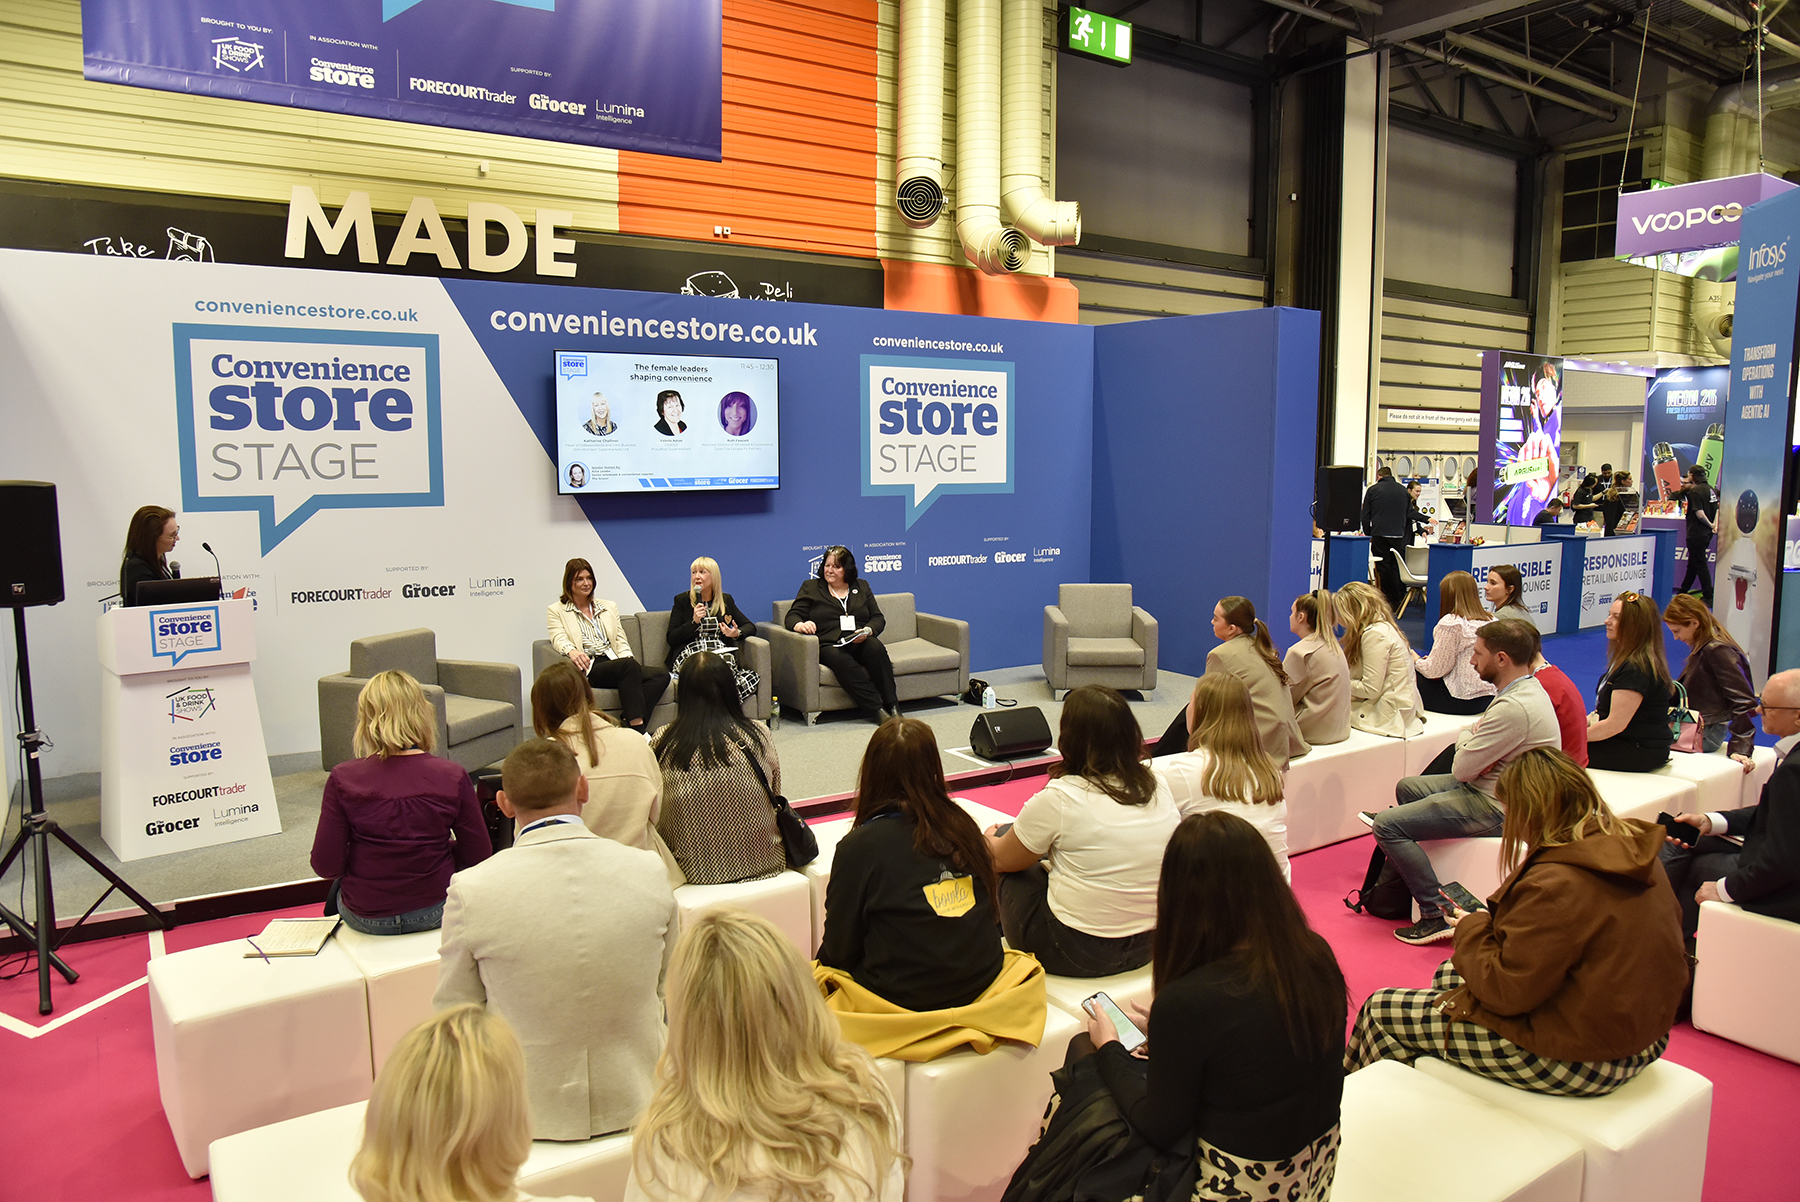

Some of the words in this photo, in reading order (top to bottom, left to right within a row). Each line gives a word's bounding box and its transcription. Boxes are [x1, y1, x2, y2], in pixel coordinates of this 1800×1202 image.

[201, 17, 234, 27] BROUGHT
[233, 45, 254, 54] FOOD
[318, 37, 360, 48] ASSOCIATION
[222, 54, 249, 64] SHOWS
[228, 50, 251, 58] DRINK
[311, 58, 374, 74] Convenience
[510, 67, 543, 77] SUPPORTED
[310, 67, 375, 89] store
[410, 78, 516, 104] FORECOURTtrader
[529, 93, 586, 116] Grocer
[596, 99, 644, 118] Lumina
[596, 114, 632, 124] Intelligence
[284, 185, 578, 277] MADE
[84, 237, 155, 259] Take
[1749, 242, 1786, 270] Infosys
[760, 282, 793, 298] Deli
[195, 300, 418, 322] conveniencestore.co.uk
[490, 310, 818, 346] conveniencestore.co.uk
[873, 336, 1003, 353] conveniencestore.co.uk
[1744, 343, 1776, 361] TRANSFORM
[211, 354, 410, 382] Convenience
[1742, 363, 1774, 381] OPERATIONS
[630, 374, 662, 382] shaping
[882, 377, 997, 398] Convenience
[1750, 385, 1764, 399] WITH
[1666, 390, 1699, 406] NEON
[1700, 389, 1717, 406] 2K
[208, 381, 413, 432] store
[1741, 404, 1763, 419] AGENTIC
[1763, 404, 1770, 418] AI
[879, 398, 998, 436] store
[212, 443, 379, 481] STAGE
[879, 444, 976, 472] STAGE
[995, 552, 1026, 563] Grocer
[1034, 547, 1060, 556] Lumina
[864, 559, 902, 573] store
[929, 554, 988, 566] FORECOURTtrader
[1584, 551, 1647, 571] RESPONSIBLE
[469, 576, 515, 589] Lumina
[1583, 572, 1618, 585] RETAILING
[1620, 569, 1646, 581] LOUNGE
[402, 584, 456, 599] Grocer
[1522, 580, 1550, 593] OUNGE
[291, 588, 392, 604] FORECOURTtrader
[1599, 596, 1612, 604] store
[159, 613, 211, 623] Convenience
[159, 620, 212, 636] store
[159, 635, 203, 649] STAGE
[170, 742, 220, 753] Convenience
[170, 748, 222, 766] store
[153, 783, 246, 807] FORECOURTtrader
[213, 804, 259, 819] Lumina
[146, 817, 200, 836] Grocer
[215, 817, 248, 827] Intelligence
[933, 882, 968, 908] bowla
